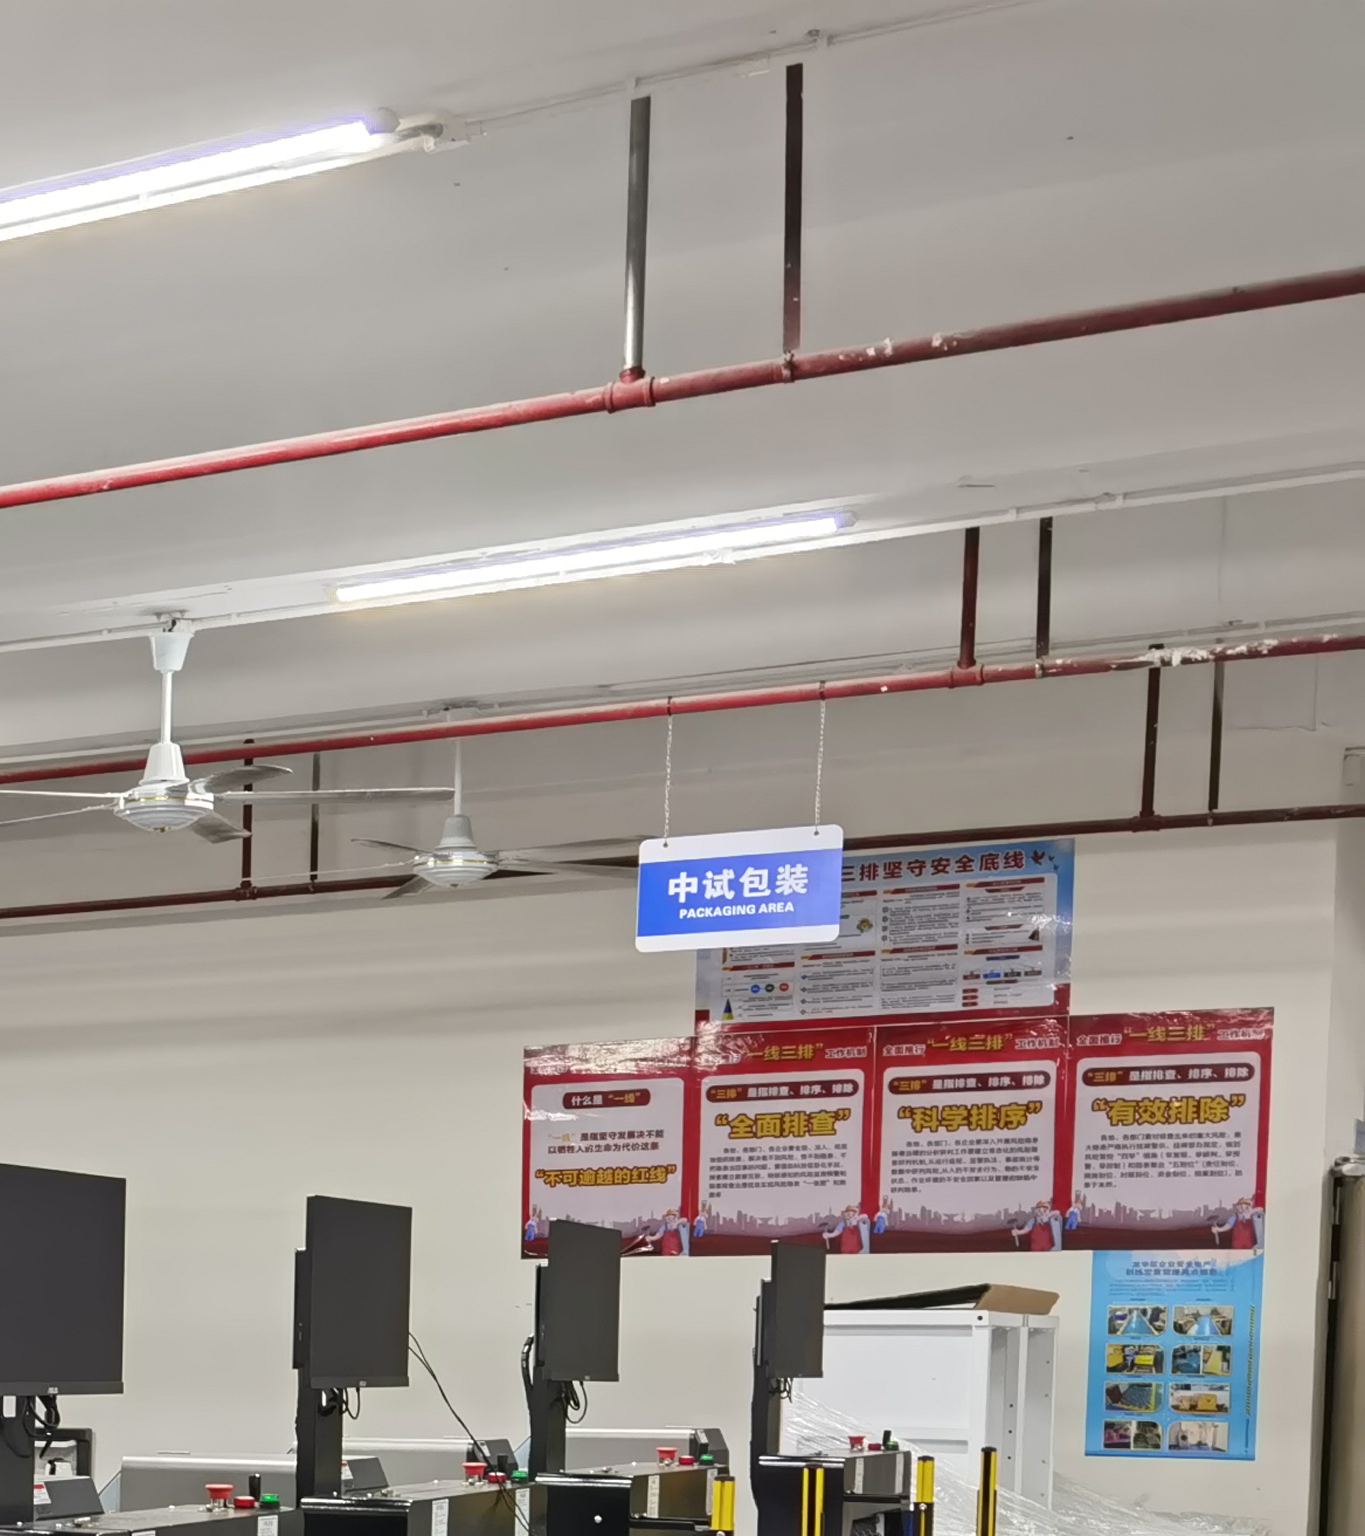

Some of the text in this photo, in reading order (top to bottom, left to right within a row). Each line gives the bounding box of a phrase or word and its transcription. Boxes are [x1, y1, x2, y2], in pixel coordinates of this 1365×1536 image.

[667, 863, 809, 904] 中试包装
[679, 901, 795, 919] PACKAGING AREA
[746, 1043, 824, 1061] 一线三排”
